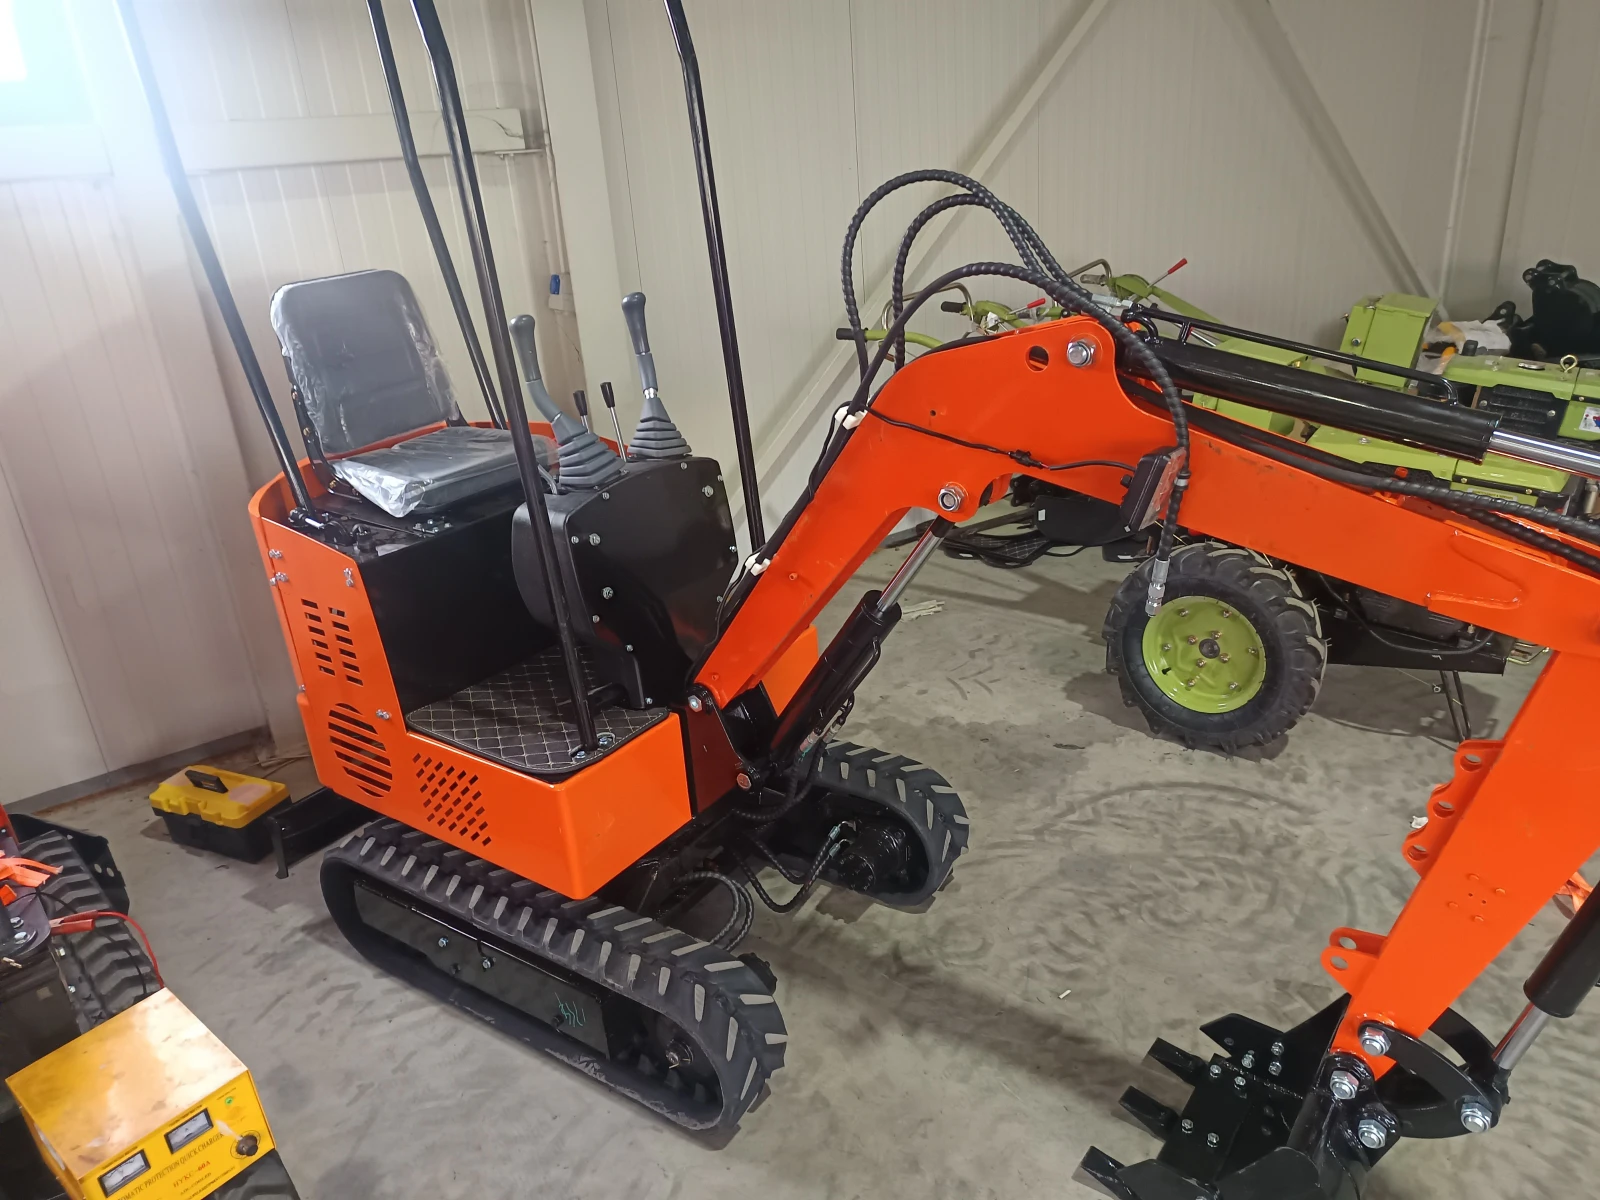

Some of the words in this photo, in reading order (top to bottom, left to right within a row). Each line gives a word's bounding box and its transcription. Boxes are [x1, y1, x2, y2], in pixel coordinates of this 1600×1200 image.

[144, 1160, 180, 1189] PROTECTION
[180, 1148, 199, 1165] QUICK
[197, 1131, 224, 1153] CHARGER
